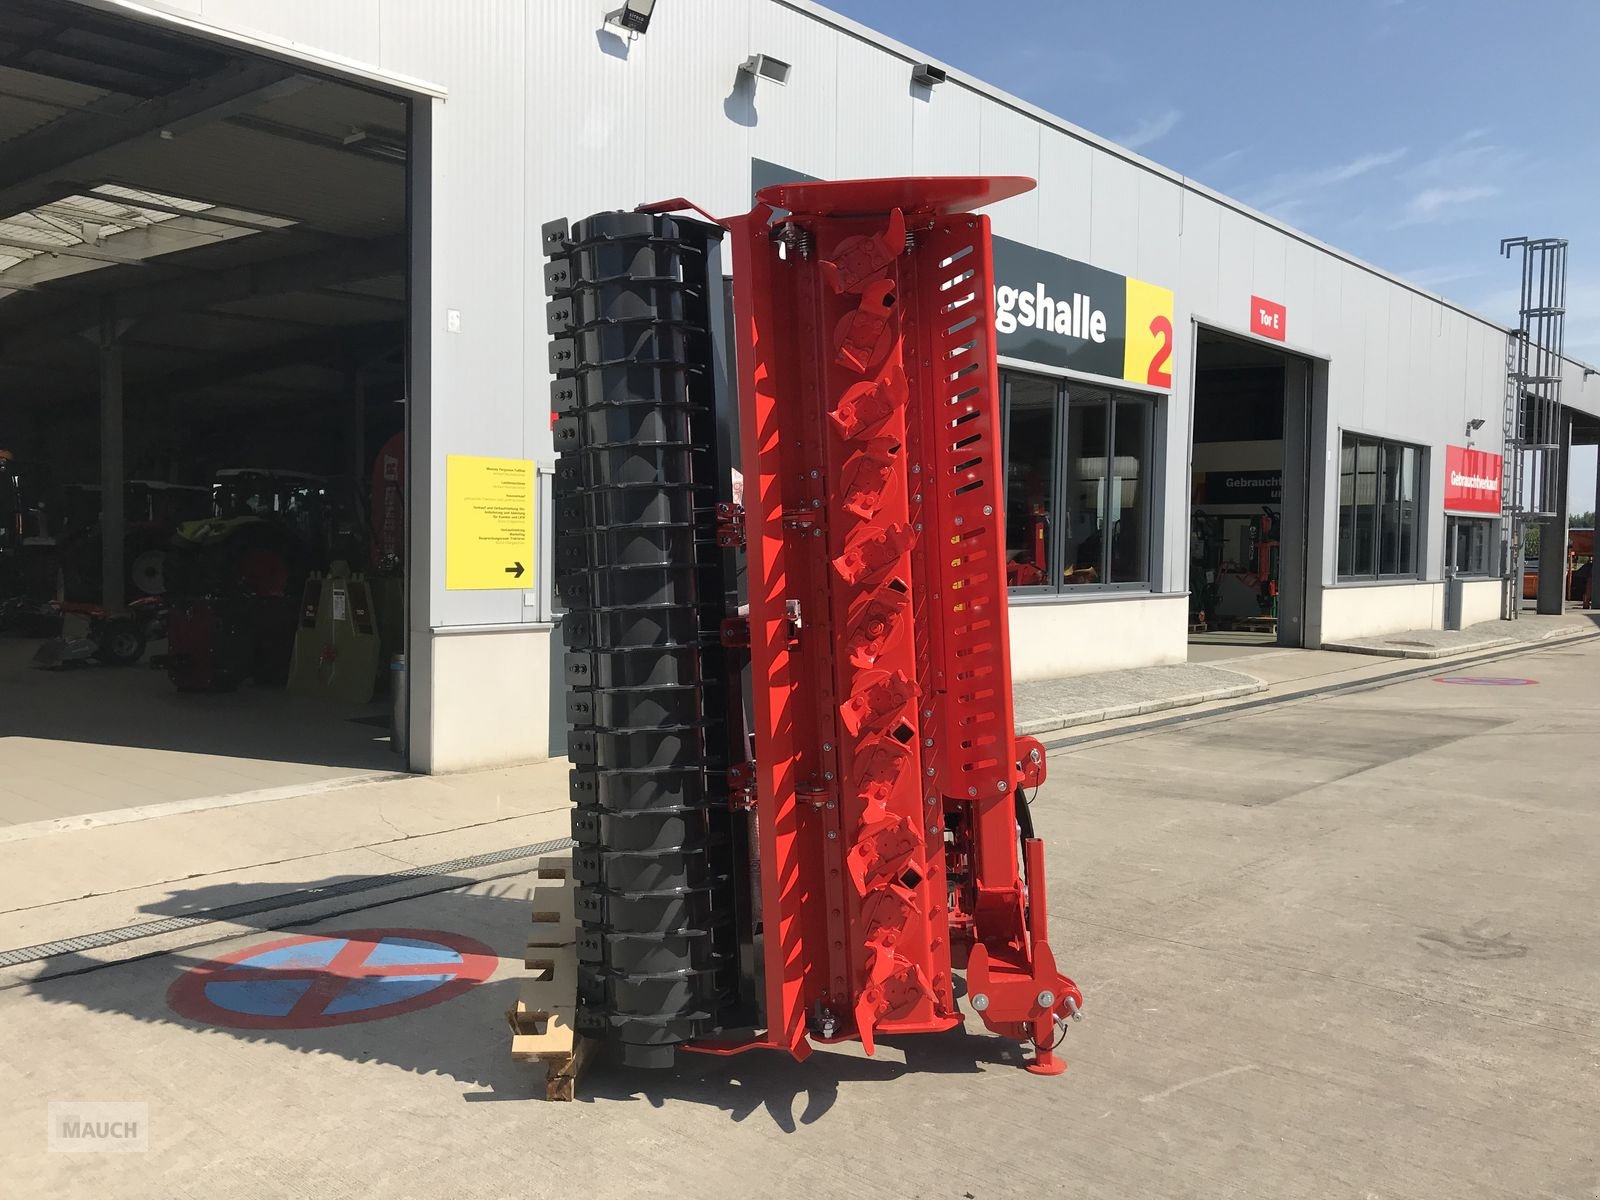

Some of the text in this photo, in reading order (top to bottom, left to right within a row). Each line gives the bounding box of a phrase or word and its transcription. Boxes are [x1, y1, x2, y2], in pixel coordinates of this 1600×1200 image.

[1260, 308, 1279, 329] Tor E
[993, 282, 1173, 389] gshalle 2
[1451, 470, 1499, 491] Gebrauchtverkauf
